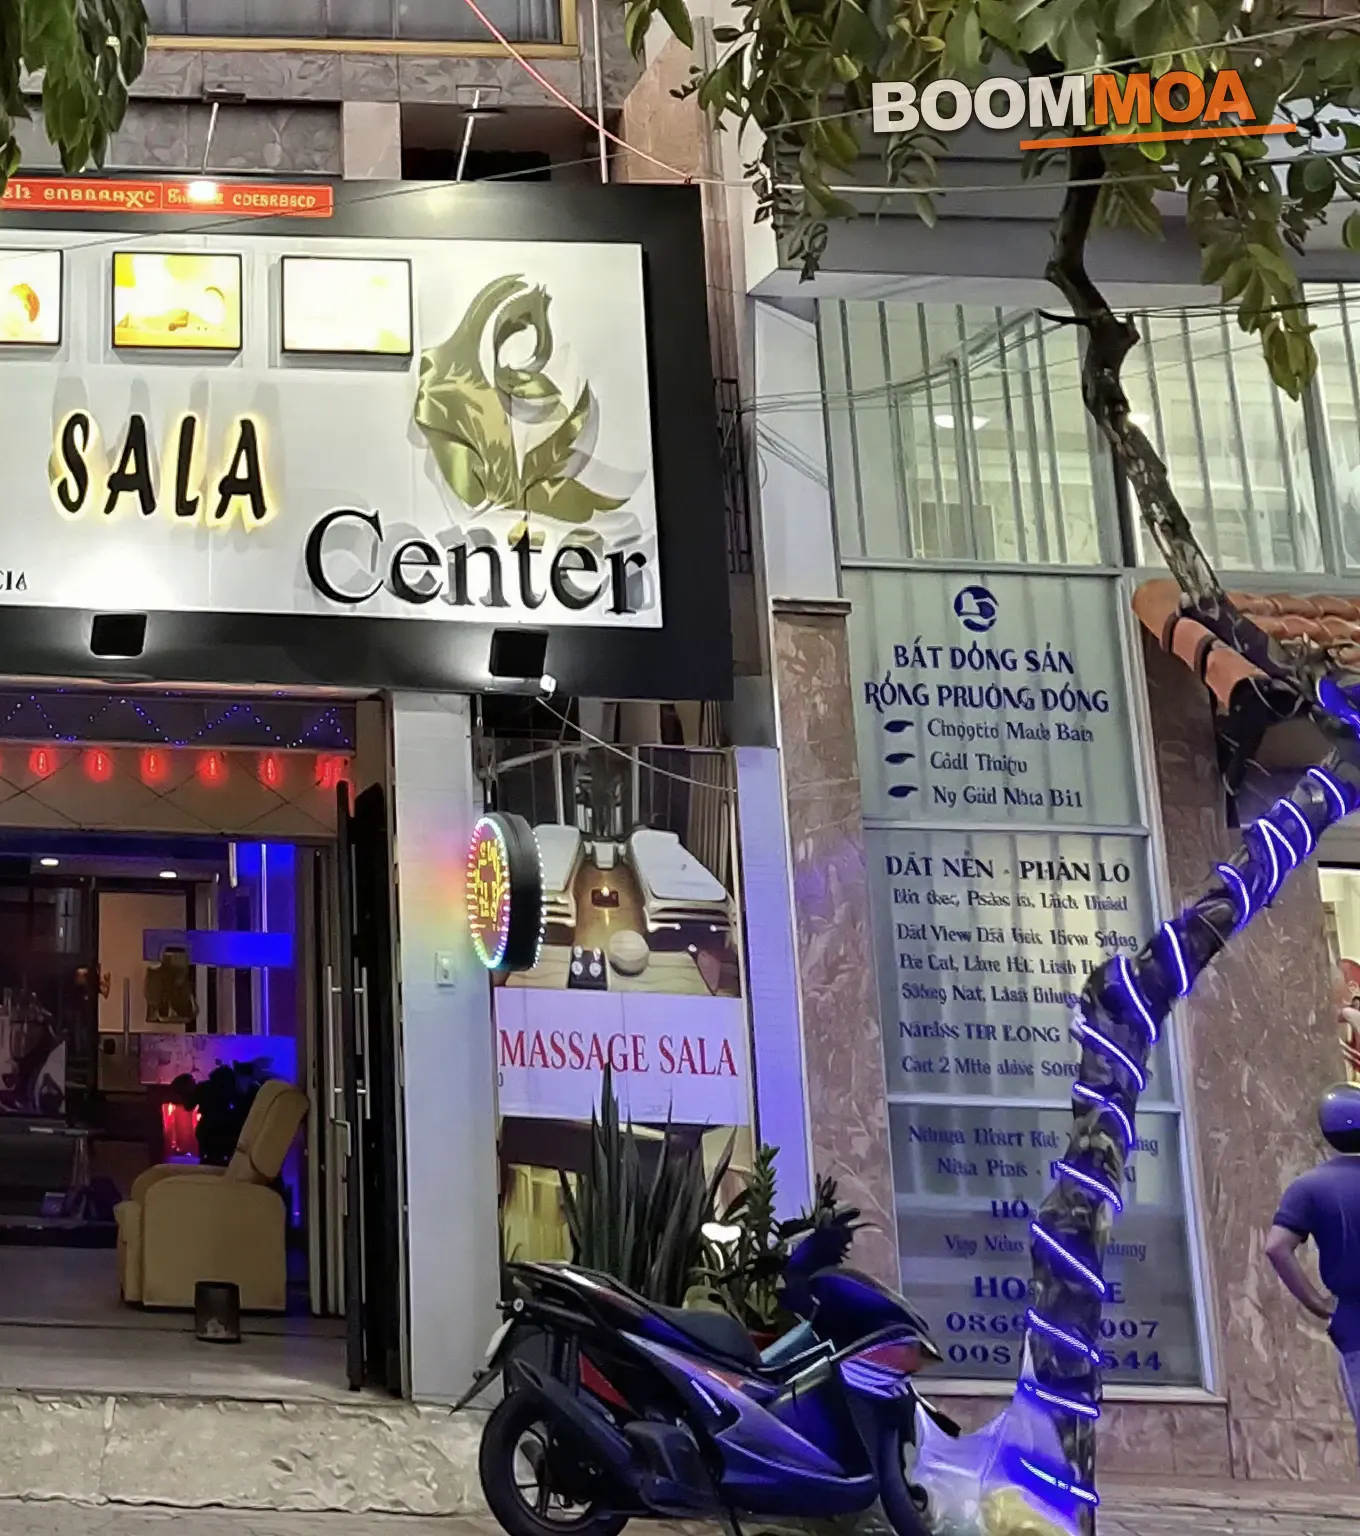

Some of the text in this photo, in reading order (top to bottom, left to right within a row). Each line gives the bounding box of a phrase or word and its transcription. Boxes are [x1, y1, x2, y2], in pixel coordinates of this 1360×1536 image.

[56, 411, 267, 520] SALA
[305, 508, 648, 615] Center
[498, 1028, 739, 1077] MASSAGE SALA
